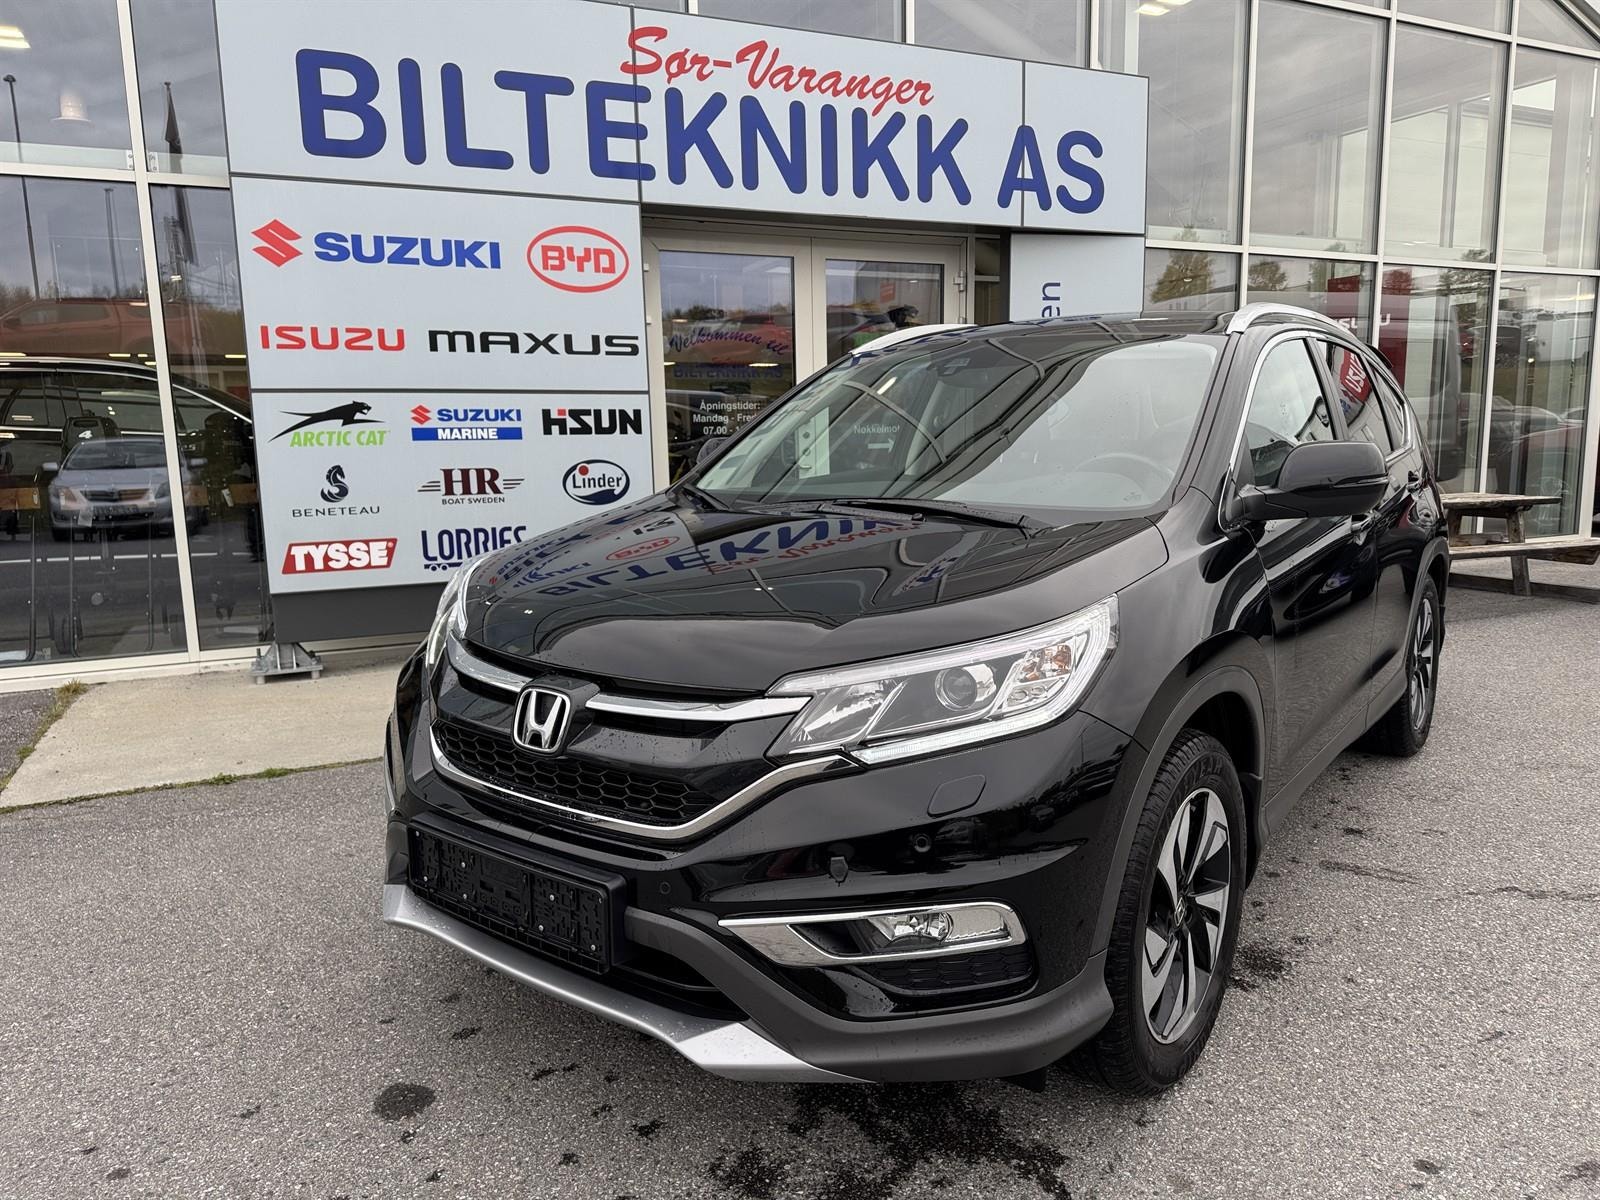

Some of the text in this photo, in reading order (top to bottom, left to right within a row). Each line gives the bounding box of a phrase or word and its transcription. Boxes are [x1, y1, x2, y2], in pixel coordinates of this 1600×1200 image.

[620, 26, 934, 117] Sør-Varanger
[295, 48, 1105, 214] BILTEKNIKK AS
[314, 231, 502, 270] SUZUKI
[541, 244, 616, 275] BYD
[260, 324, 406, 352] ISUZU
[428, 329, 640, 357] MAXUS
[669, 327, 762, 352] Velkommen
[435, 407, 523, 423] SUZUKI
[699, 399, 761, 413] Åpningstider:
[692, 414, 729, 424] Mandag
[289, 429, 387, 448] ARCTIC CAT
[437, 427, 499, 440] MARINE
[703, 426, 728, 435] 07.00
[440, 467, 504, 497] HR
[572, 472, 623, 490] Linder
[291, 505, 381, 518] BENETEAU
[441, 496, 506, 506] BOAT SWEDEN
[290, 542, 388, 569] TYSSE
